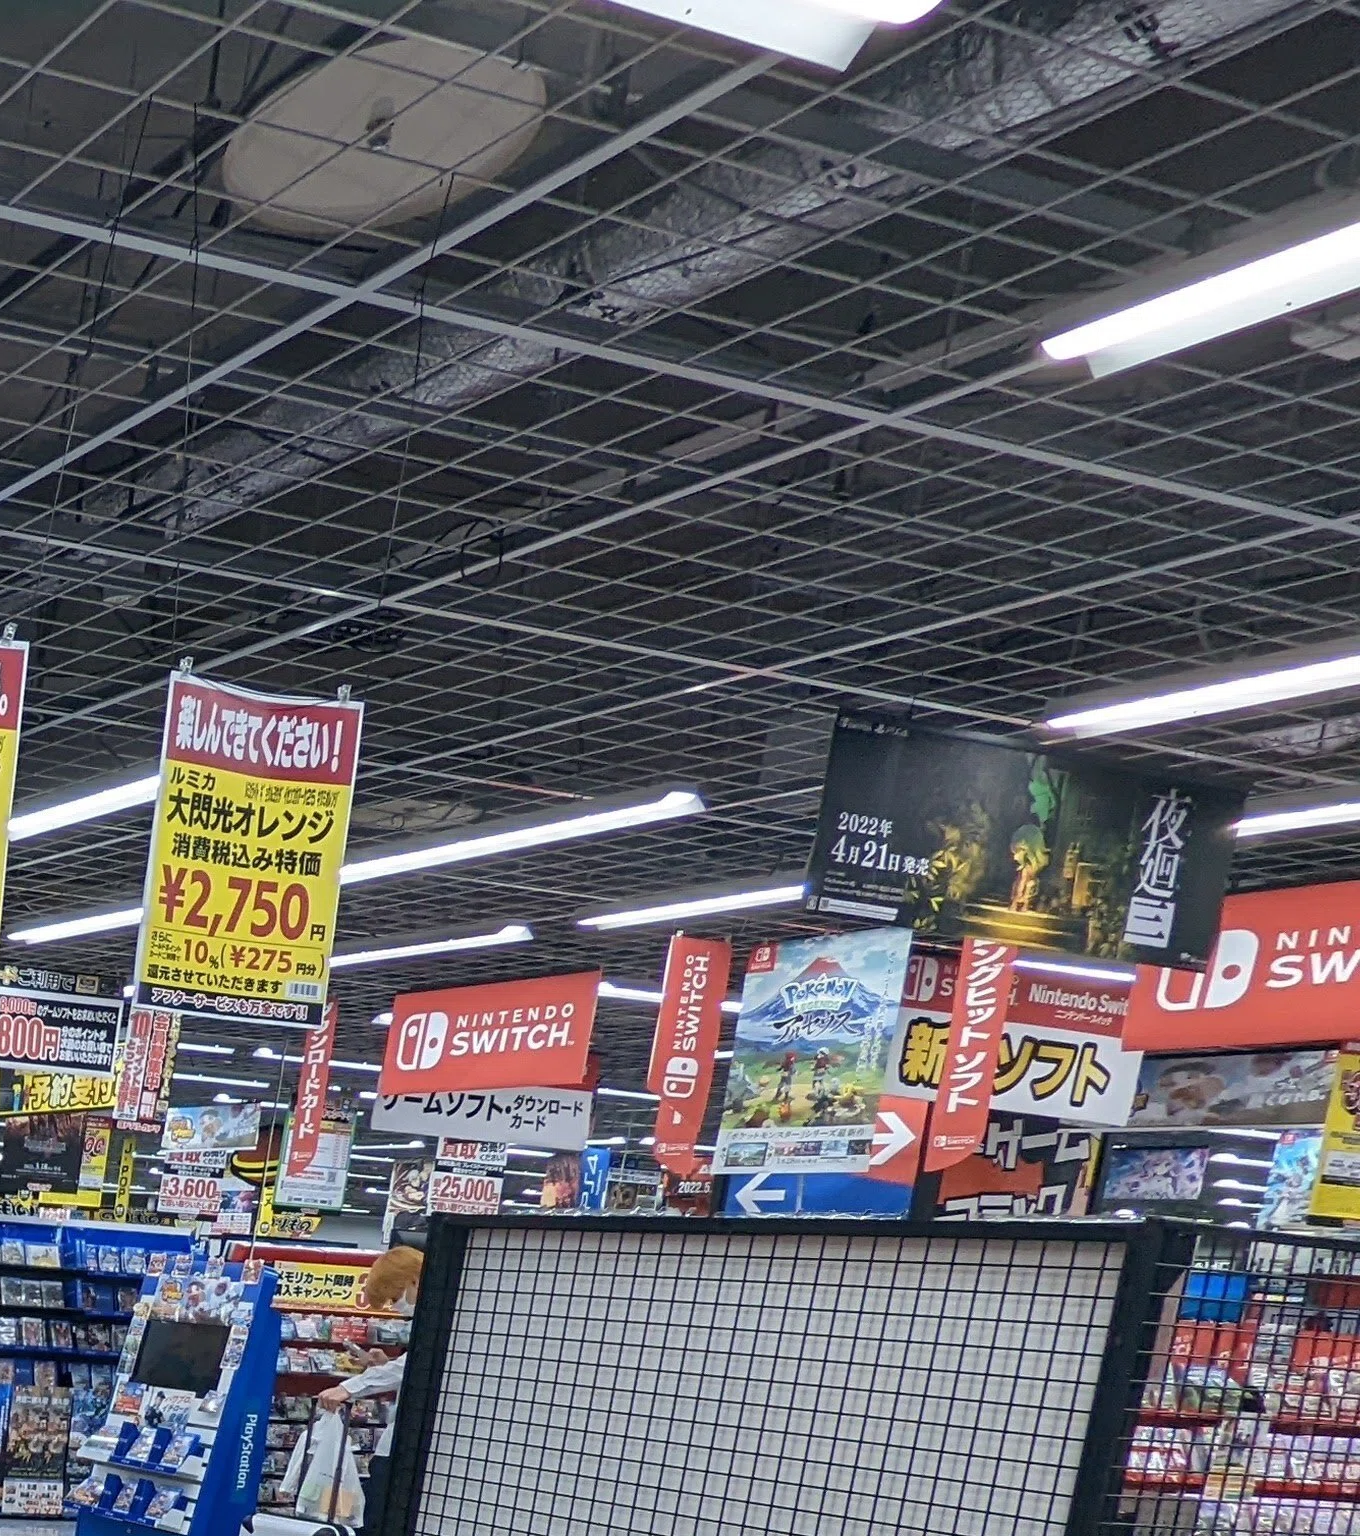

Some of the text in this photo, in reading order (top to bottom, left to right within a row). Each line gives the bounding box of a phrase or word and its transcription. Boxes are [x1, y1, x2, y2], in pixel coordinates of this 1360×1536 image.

[176, 696, 343, 773] 楽しんできてください!
[170, 767, 216, 790] ルミカ
[167, 789, 334, 844] 大閃光オレンジ
[838, 811, 894, 838] 2022年
[172, 832, 322, 877] 消費税込み特価
[830, 838, 931, 877] 4月21日発売
[456, 1002, 575, 1029] NINTENDO
[670, 953, 696, 1051] NINTENDO
[1028, 983, 1095, 1015] Nintendo
[450, 1020, 570, 1056] SWITCH
[235, 1413, 258, 1491] PlayStation
